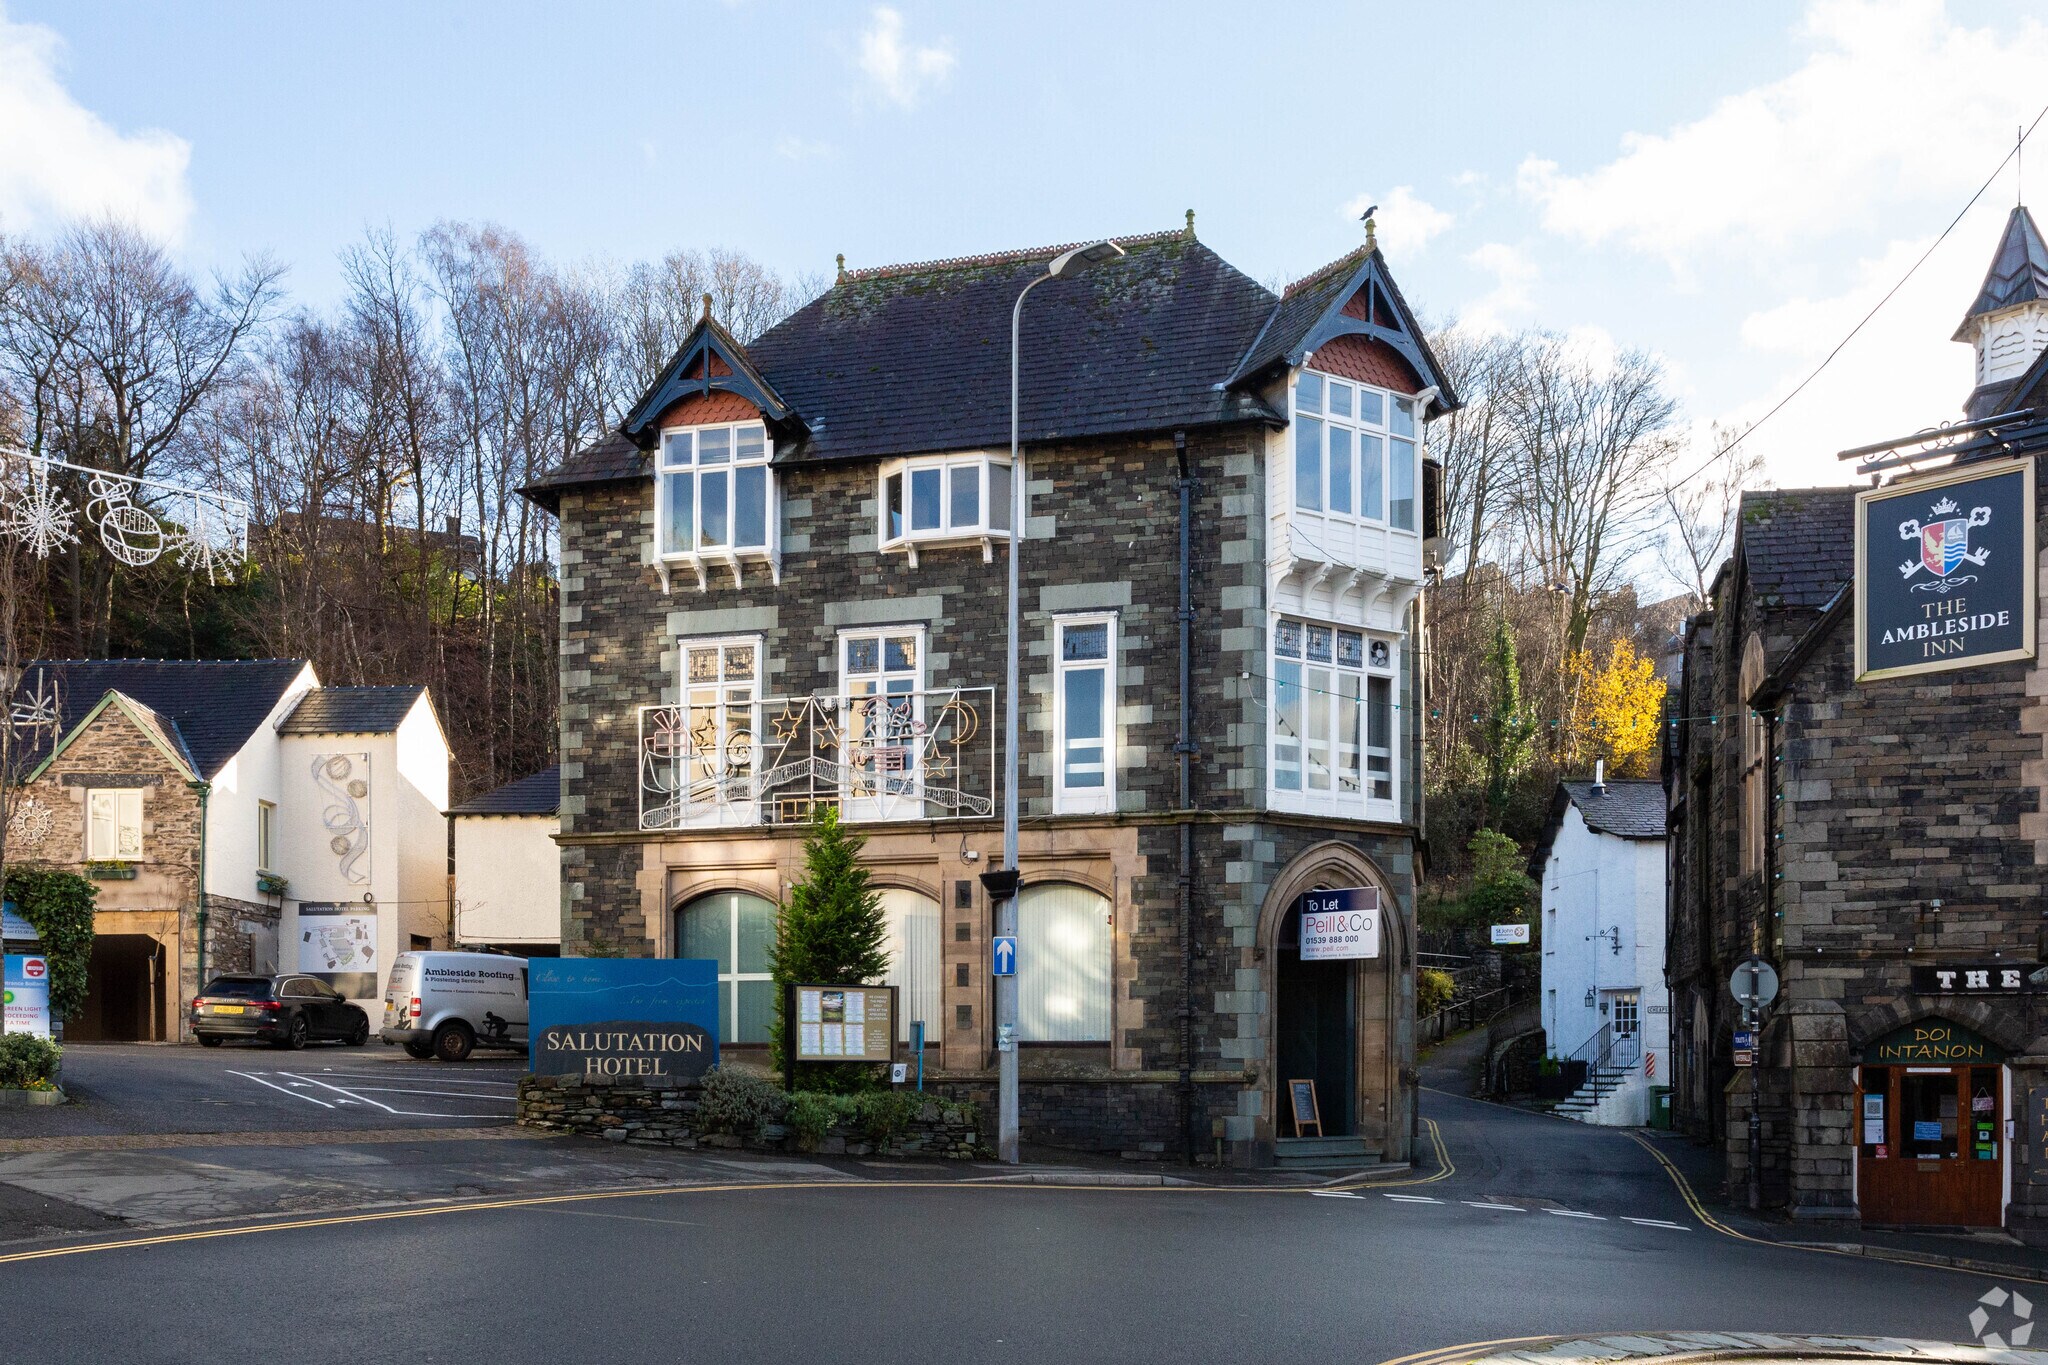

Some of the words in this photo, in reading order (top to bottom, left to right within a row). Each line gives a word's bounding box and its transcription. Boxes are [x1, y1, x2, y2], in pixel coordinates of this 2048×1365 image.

[1921, 598, 1967, 618] THE
[1881, 610, 2010, 645] AMBLESIDE
[1923, 637, 1965, 657] INN
[1307, 899, 1319, 911] To
[1322, 898, 1339, 911] Let
[1305, 937, 1327, 945] 01539
[1328, 936, 1343, 944] 888
[1345, 935, 1359, 943] 000
[424, 968, 476, 978] Ambleside
[478, 970, 514, 981] Roofing
[430, 976, 460, 984] Plastering
[1936, 970, 2021, 989] THE
[547, 1031, 704, 1052] SALUTATION
[1915, 1028, 1951, 1042] DOI
[1879, 1044, 1984, 1059] INTANON
[584, 1056, 669, 1076] HOTEL
